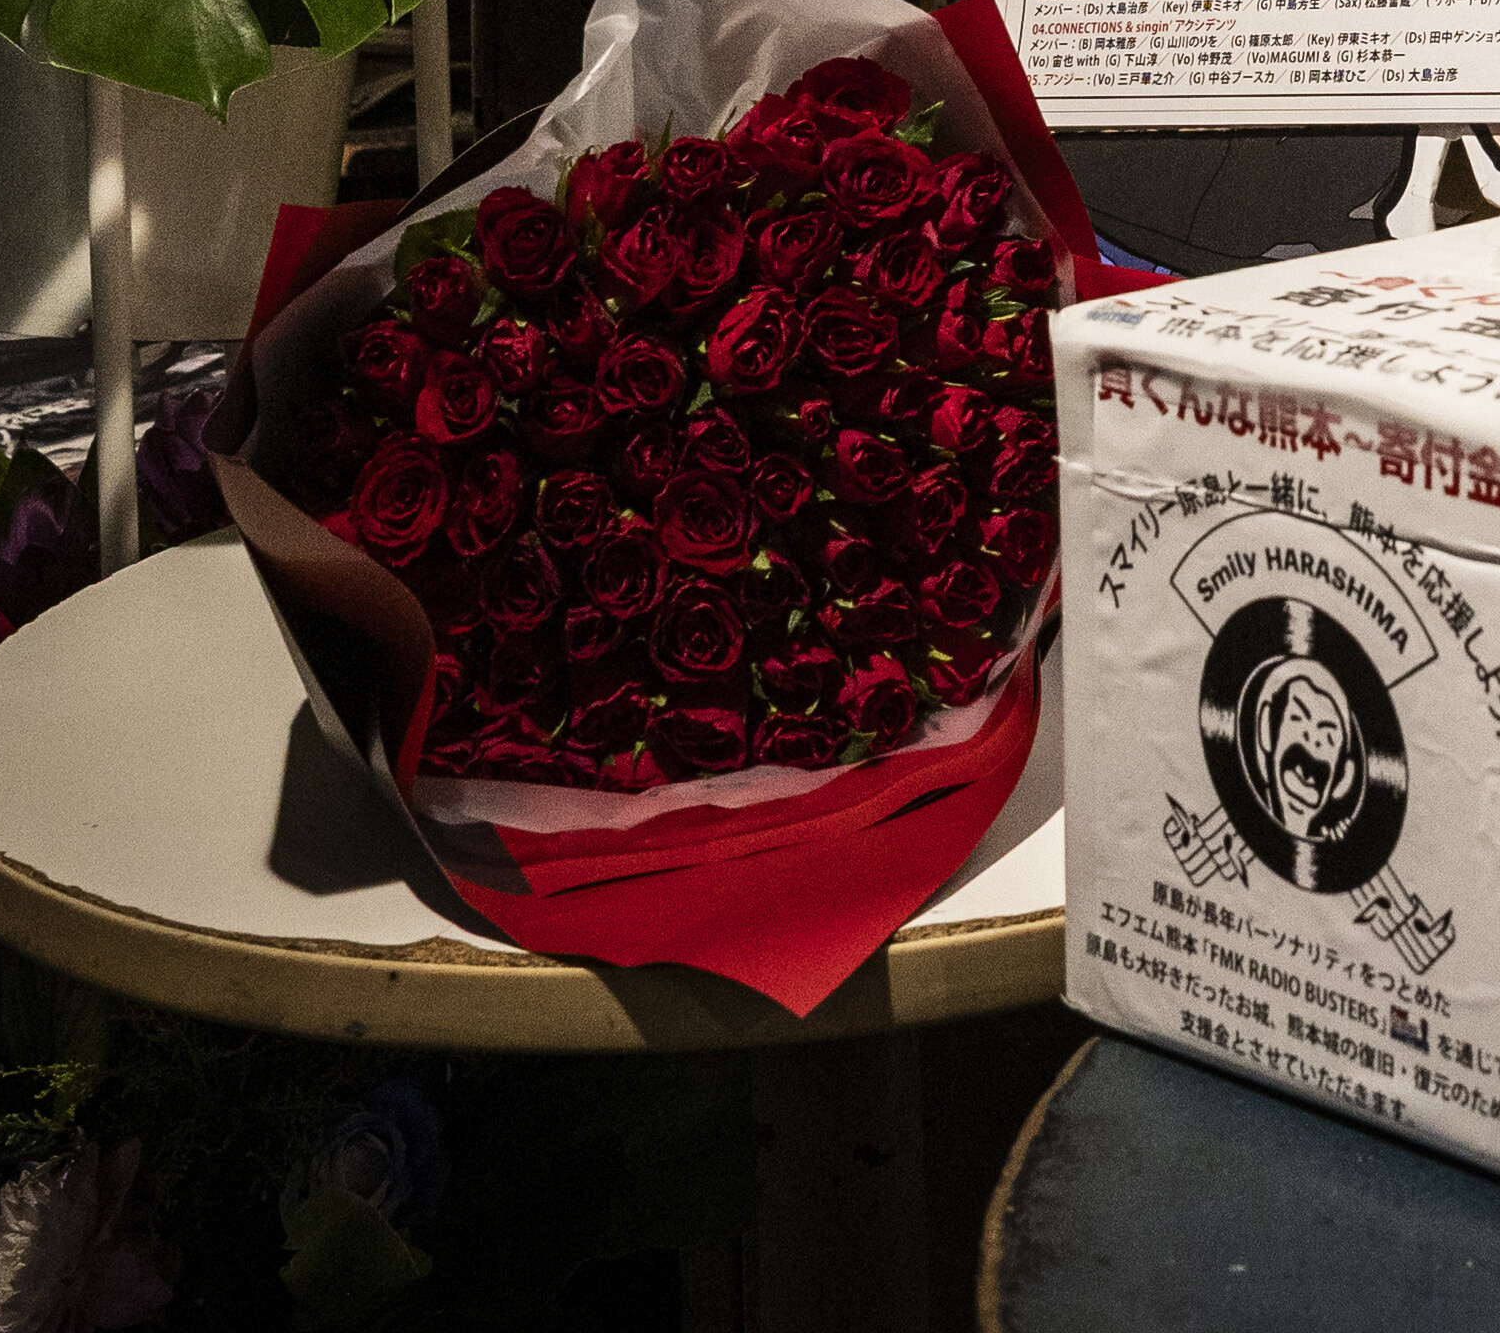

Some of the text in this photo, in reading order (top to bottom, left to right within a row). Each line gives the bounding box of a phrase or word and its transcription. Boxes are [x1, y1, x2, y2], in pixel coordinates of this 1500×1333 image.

[1198, 546, 1410, 654] Smily HARASHIMA
[1248, 956, 1301, 997] RADIO
